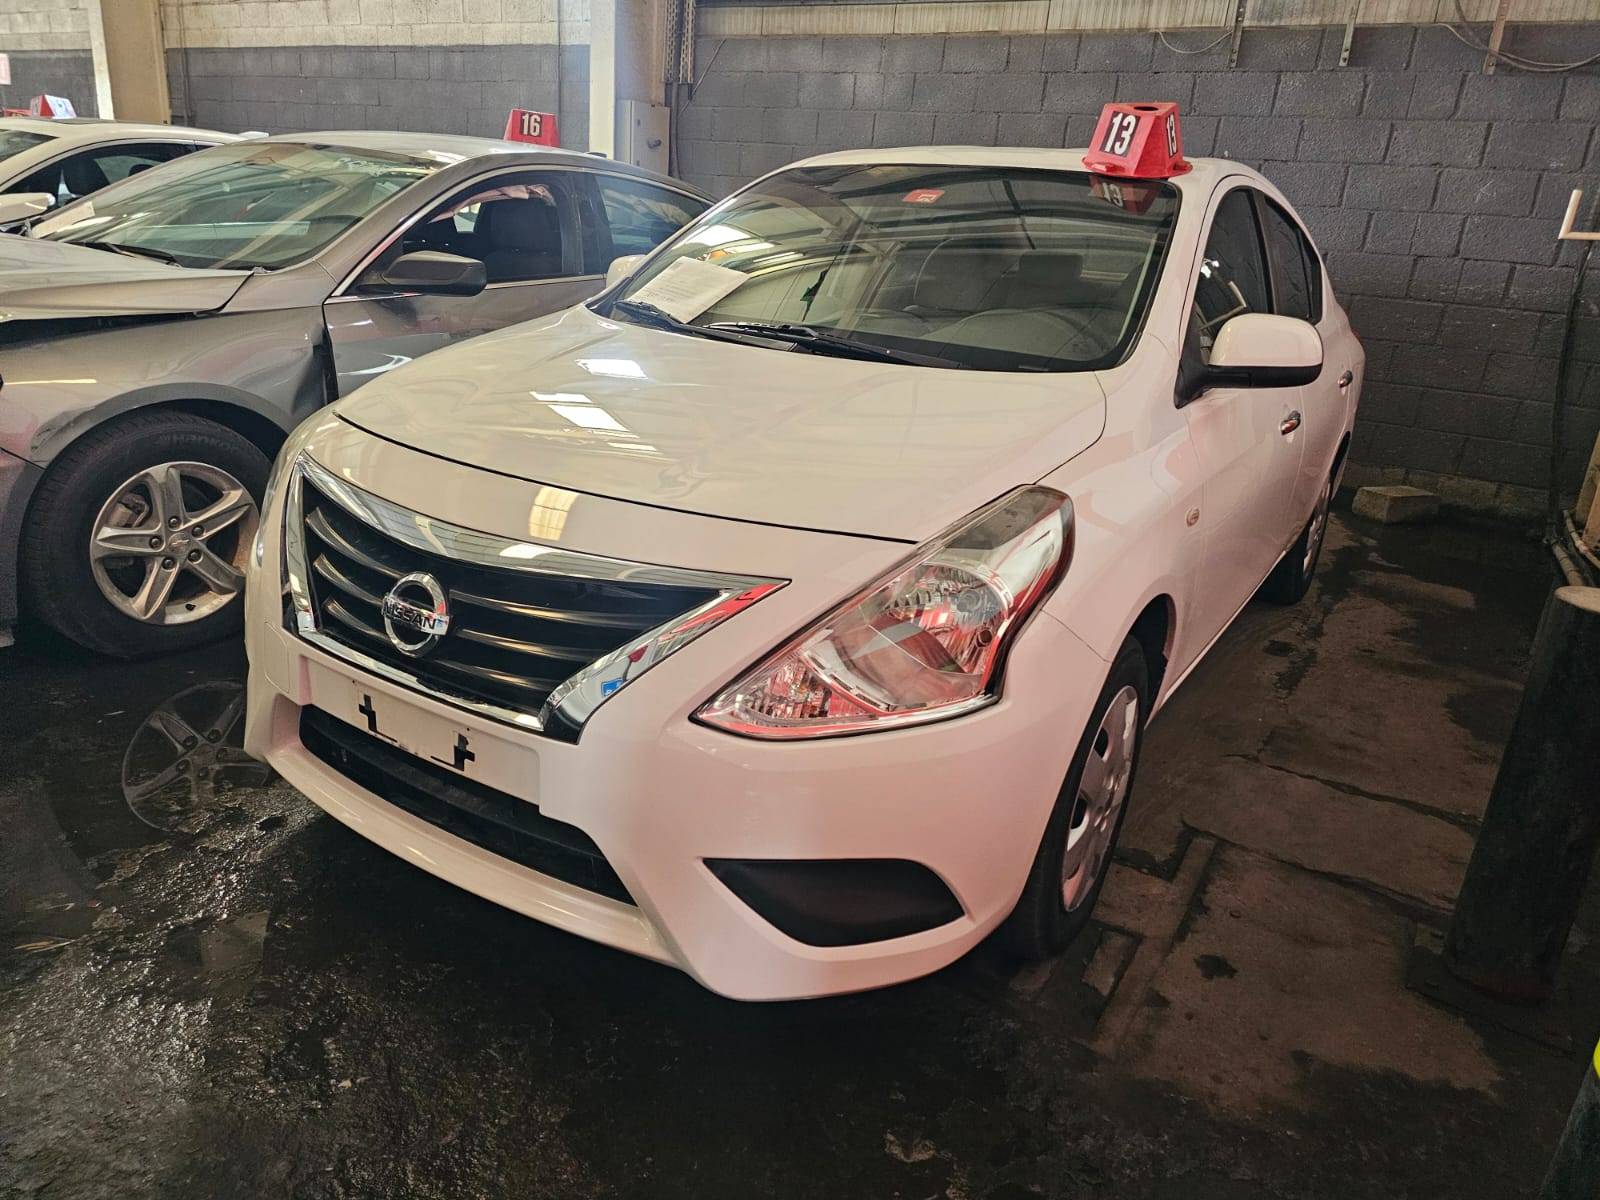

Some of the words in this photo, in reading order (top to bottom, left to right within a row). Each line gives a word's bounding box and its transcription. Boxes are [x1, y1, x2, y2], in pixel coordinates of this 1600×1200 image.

[521, 112, 541, 137] 16
[1103, 112, 1137, 156] 13
[1166, 113, 1177, 157] 13
[383, 601, 437, 630] NISSAN
